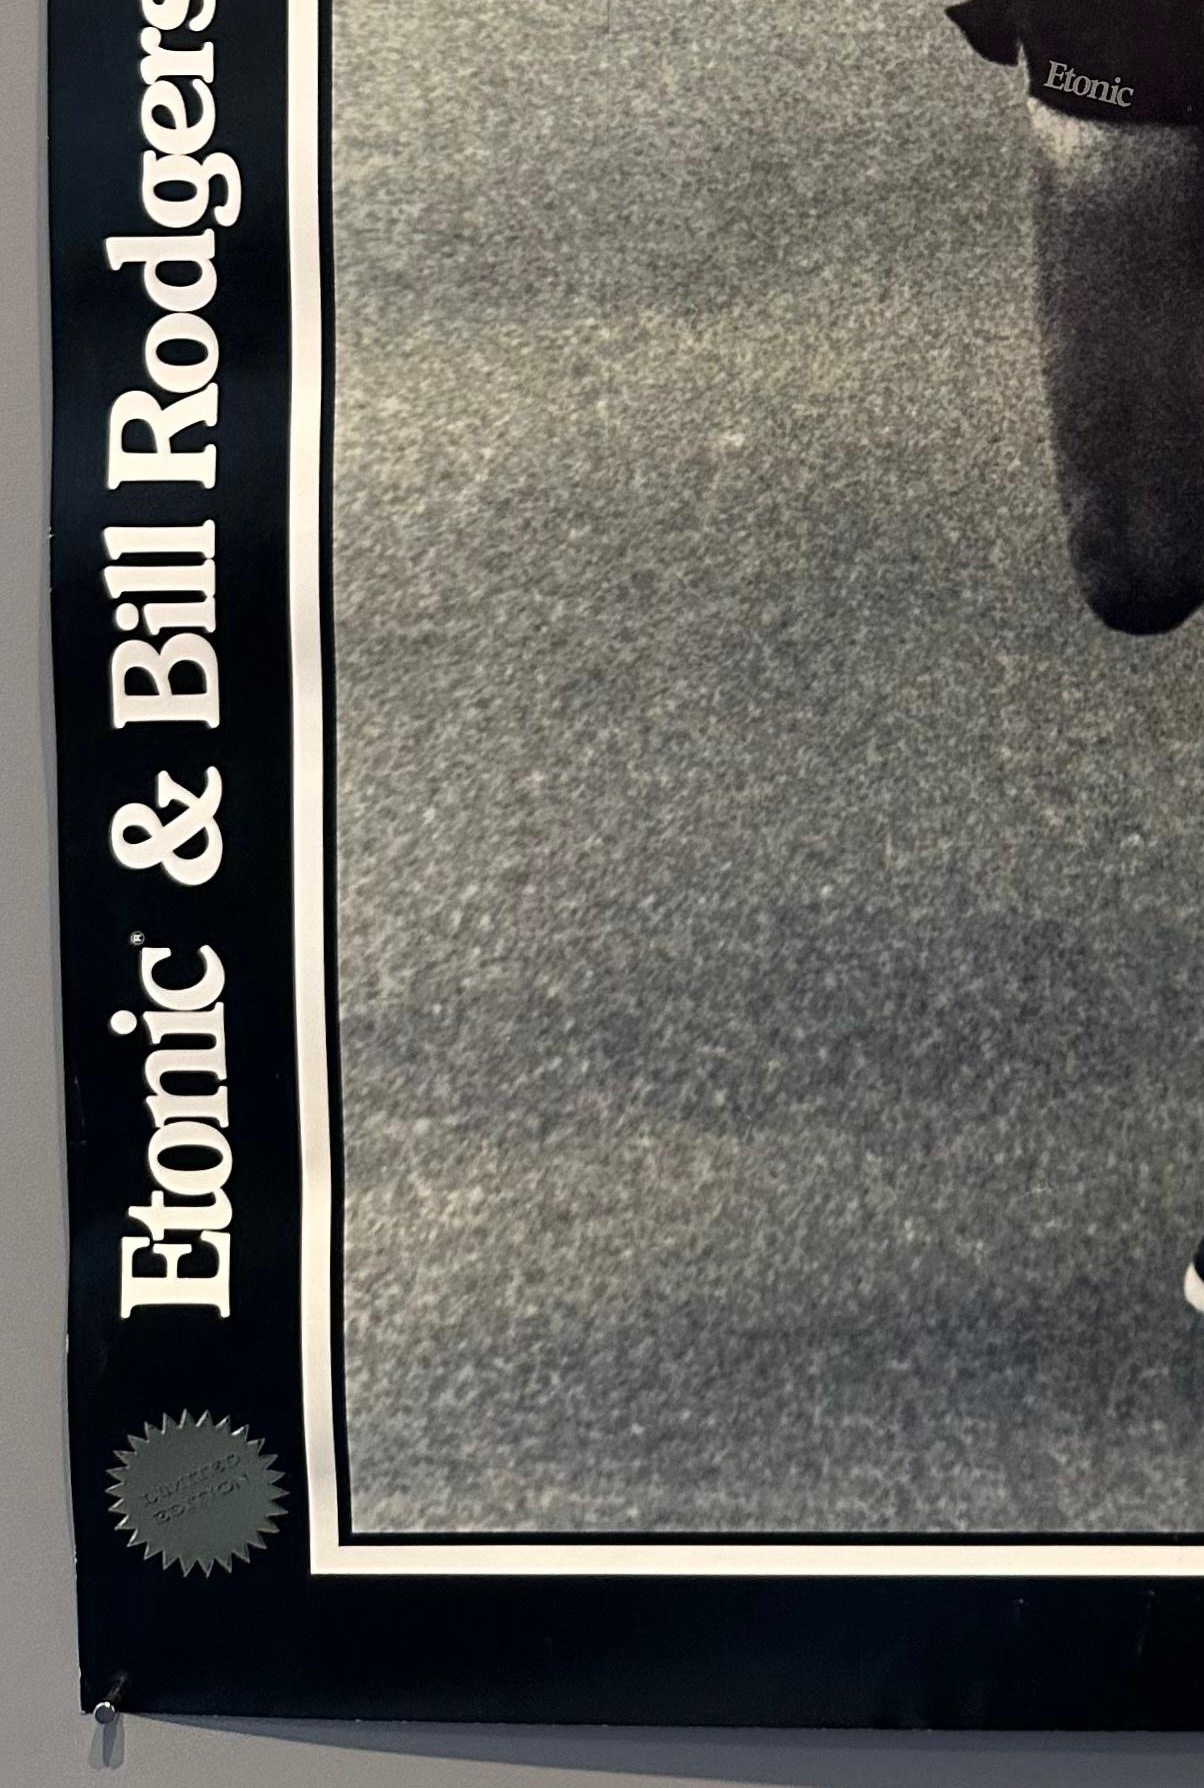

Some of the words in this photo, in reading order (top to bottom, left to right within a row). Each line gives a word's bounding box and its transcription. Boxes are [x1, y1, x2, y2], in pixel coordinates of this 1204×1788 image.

[1043, 60, 1134, 108] Etonic
[104, 520, 219, 728] Bill
[111, 766, 222, 885] &
